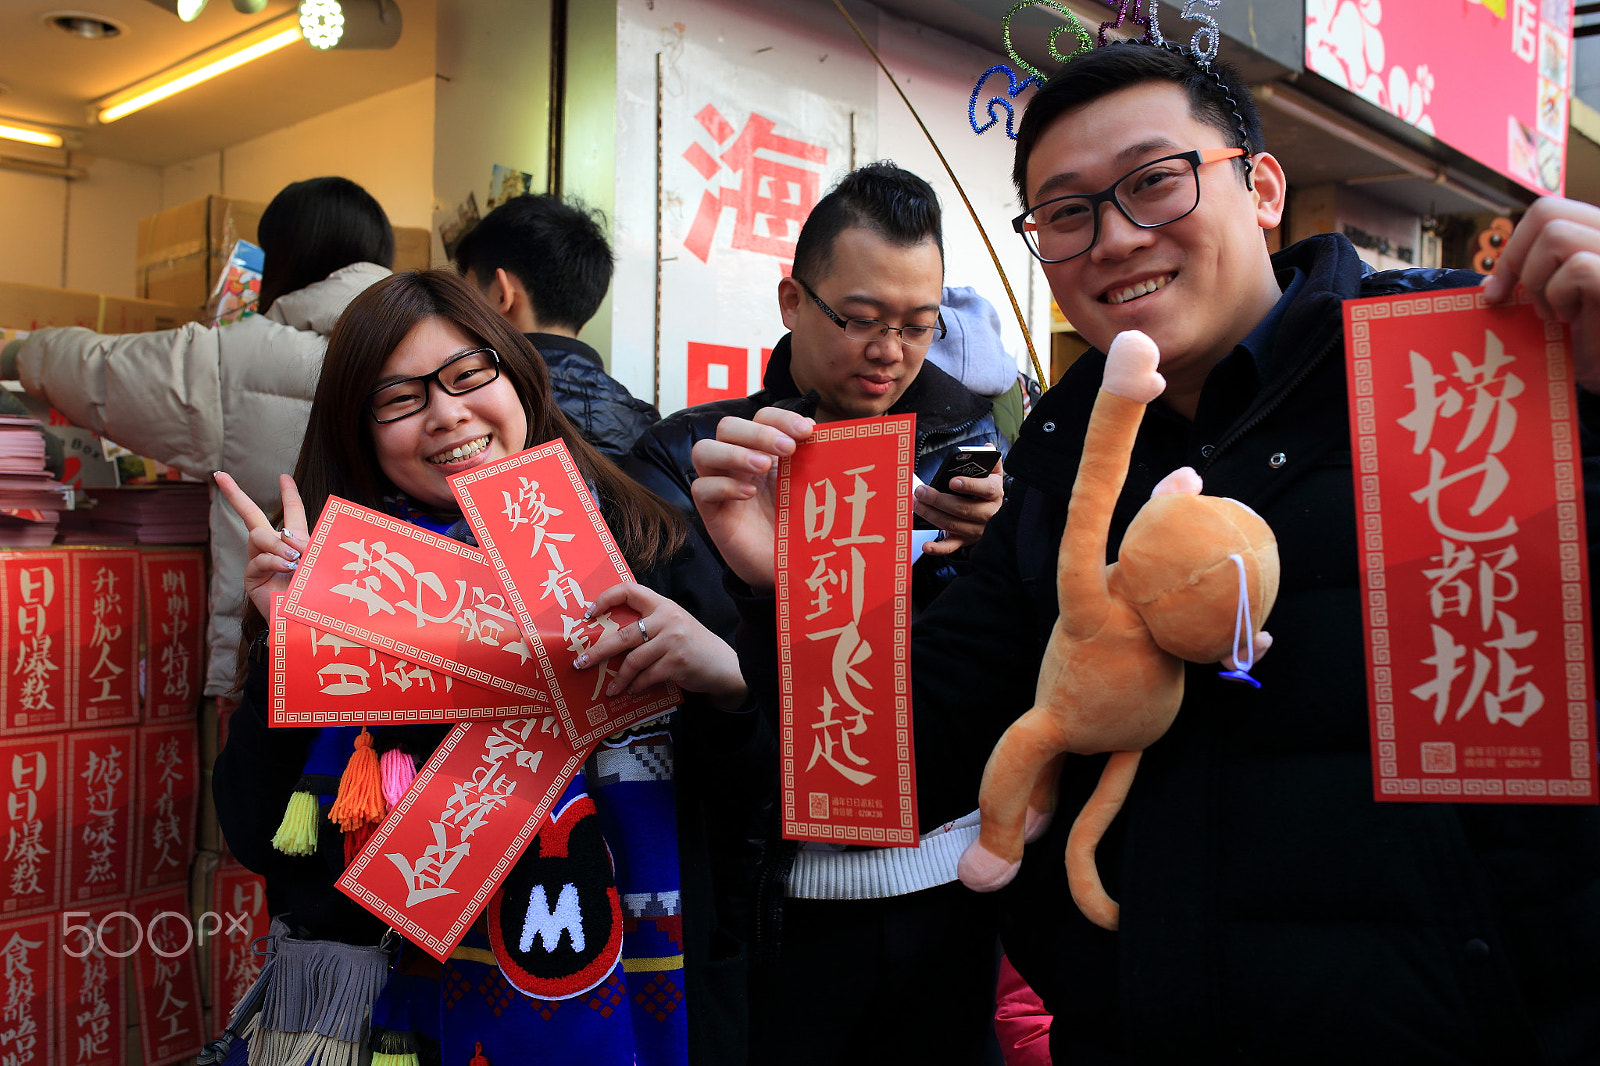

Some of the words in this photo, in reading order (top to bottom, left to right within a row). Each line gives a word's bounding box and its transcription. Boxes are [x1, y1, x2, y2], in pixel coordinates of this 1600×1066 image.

[804, 464, 886, 785] 旺到飞起
[519, 883, 585, 953] M
